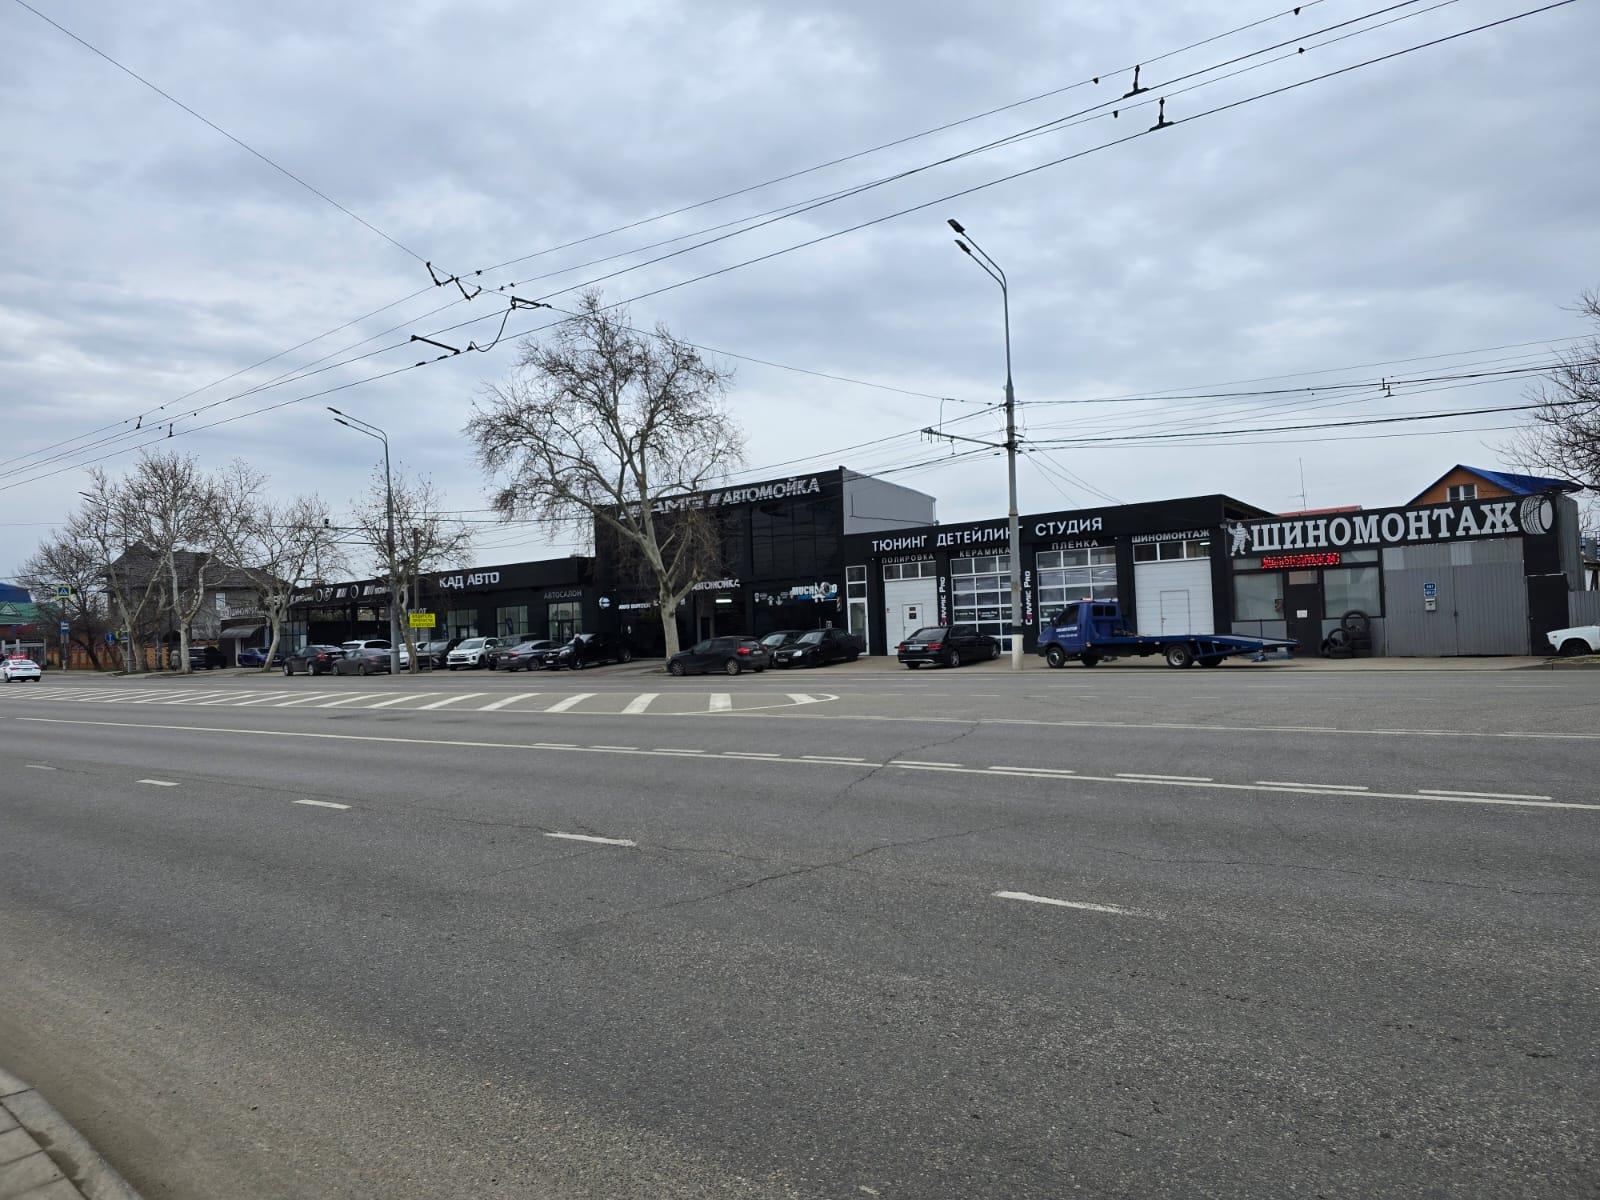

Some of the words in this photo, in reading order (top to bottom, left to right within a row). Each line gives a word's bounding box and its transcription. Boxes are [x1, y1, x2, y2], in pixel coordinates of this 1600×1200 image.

[720, 477, 820, 506] АВТОМОЙКА
[1251, 501, 1519, 552] ШИНОМОНТАЖ
[872, 535, 928, 552] ТЮНИНГ
[936, 525, 1023, 547] ДЕТЕЙЛИН
[1035, 517, 1103, 537] СТУДИЯ
[1131, 529, 1210, 543] ШИНОМОНТАЖ
[959, 546, 1011, 558] КЕРАМИКА
[1052, 539, 1099, 551] ПЛЕНКА
[881, 553, 934, 564] ПОЛИРОВКА
[439, 575, 464, 589] КАД
[466, 571, 500, 586] АВТО
[543, 590, 582, 600] АВТОСАЛОН
